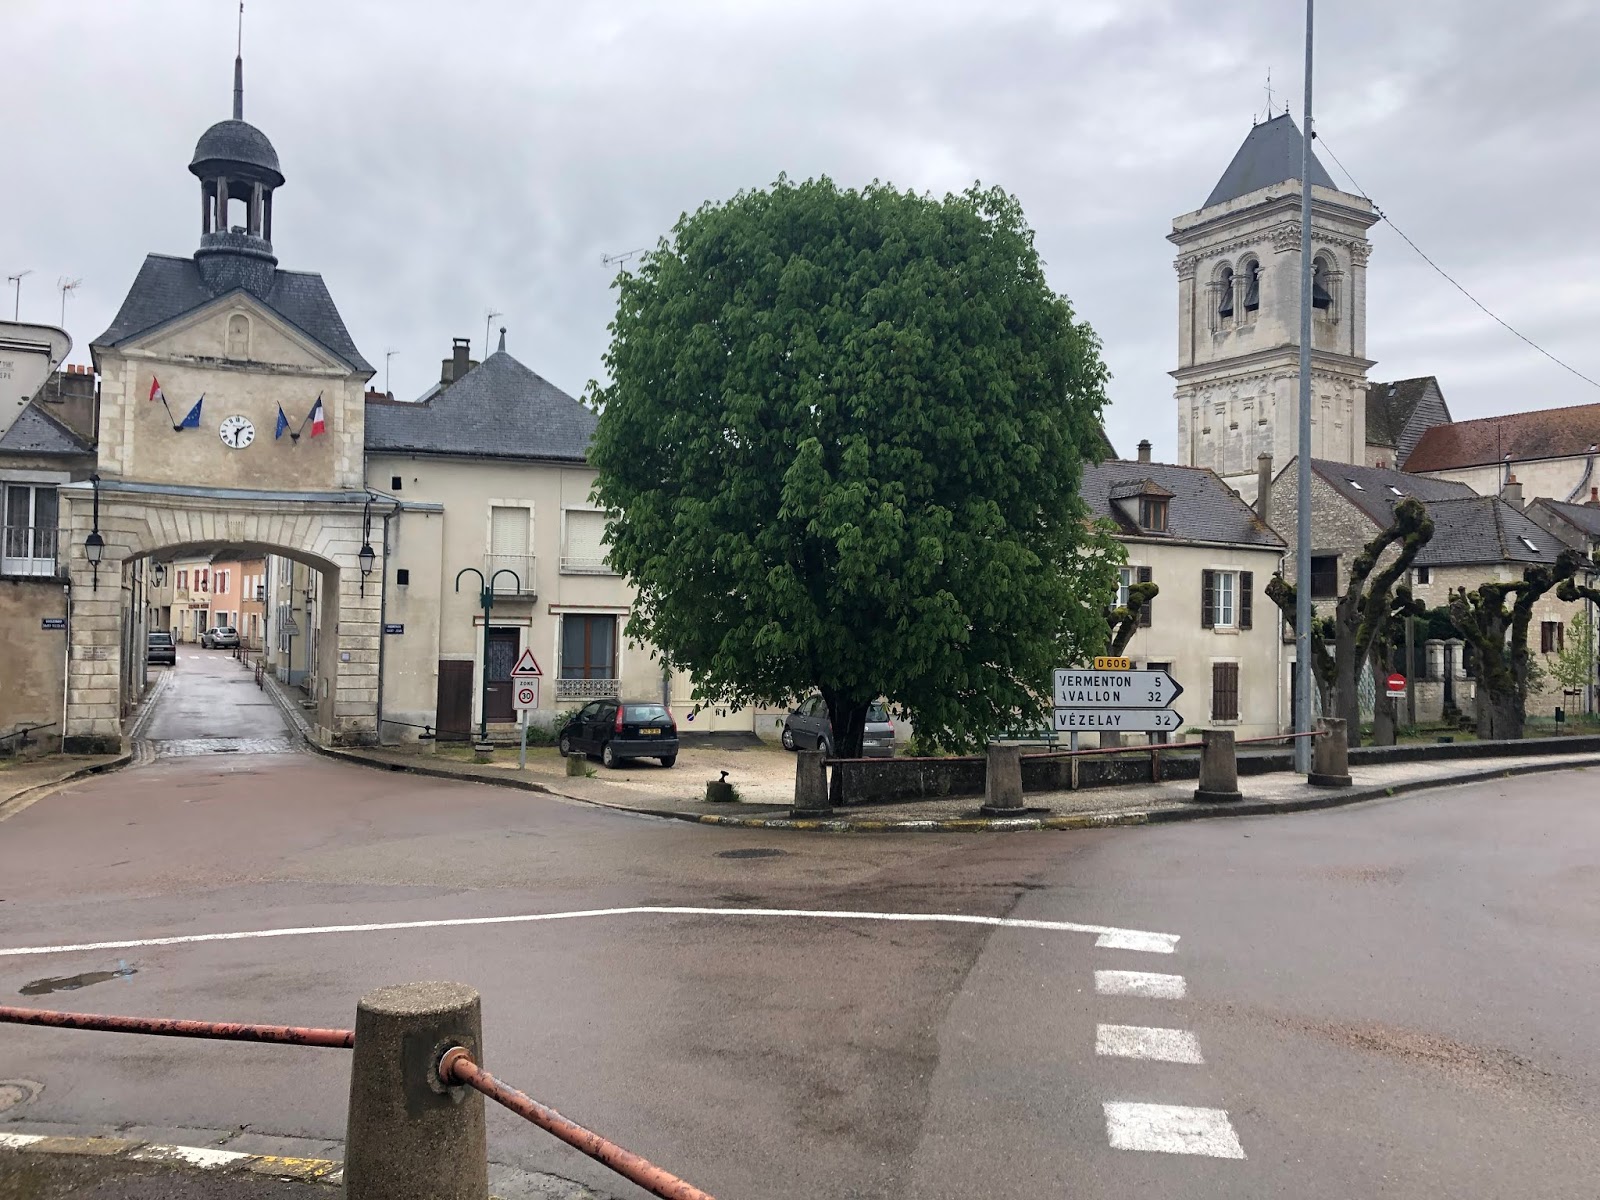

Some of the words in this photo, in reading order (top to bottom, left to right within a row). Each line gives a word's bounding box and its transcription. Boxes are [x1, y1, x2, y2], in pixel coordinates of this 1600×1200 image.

[1059, 675, 1132, 686] VERMENTON
[1155, 677, 1162, 687] 5
[1148, 692, 1162, 702] 32
[1059, 712, 1121, 726] VÉZELAY
[1155, 715, 1171, 726] 32
